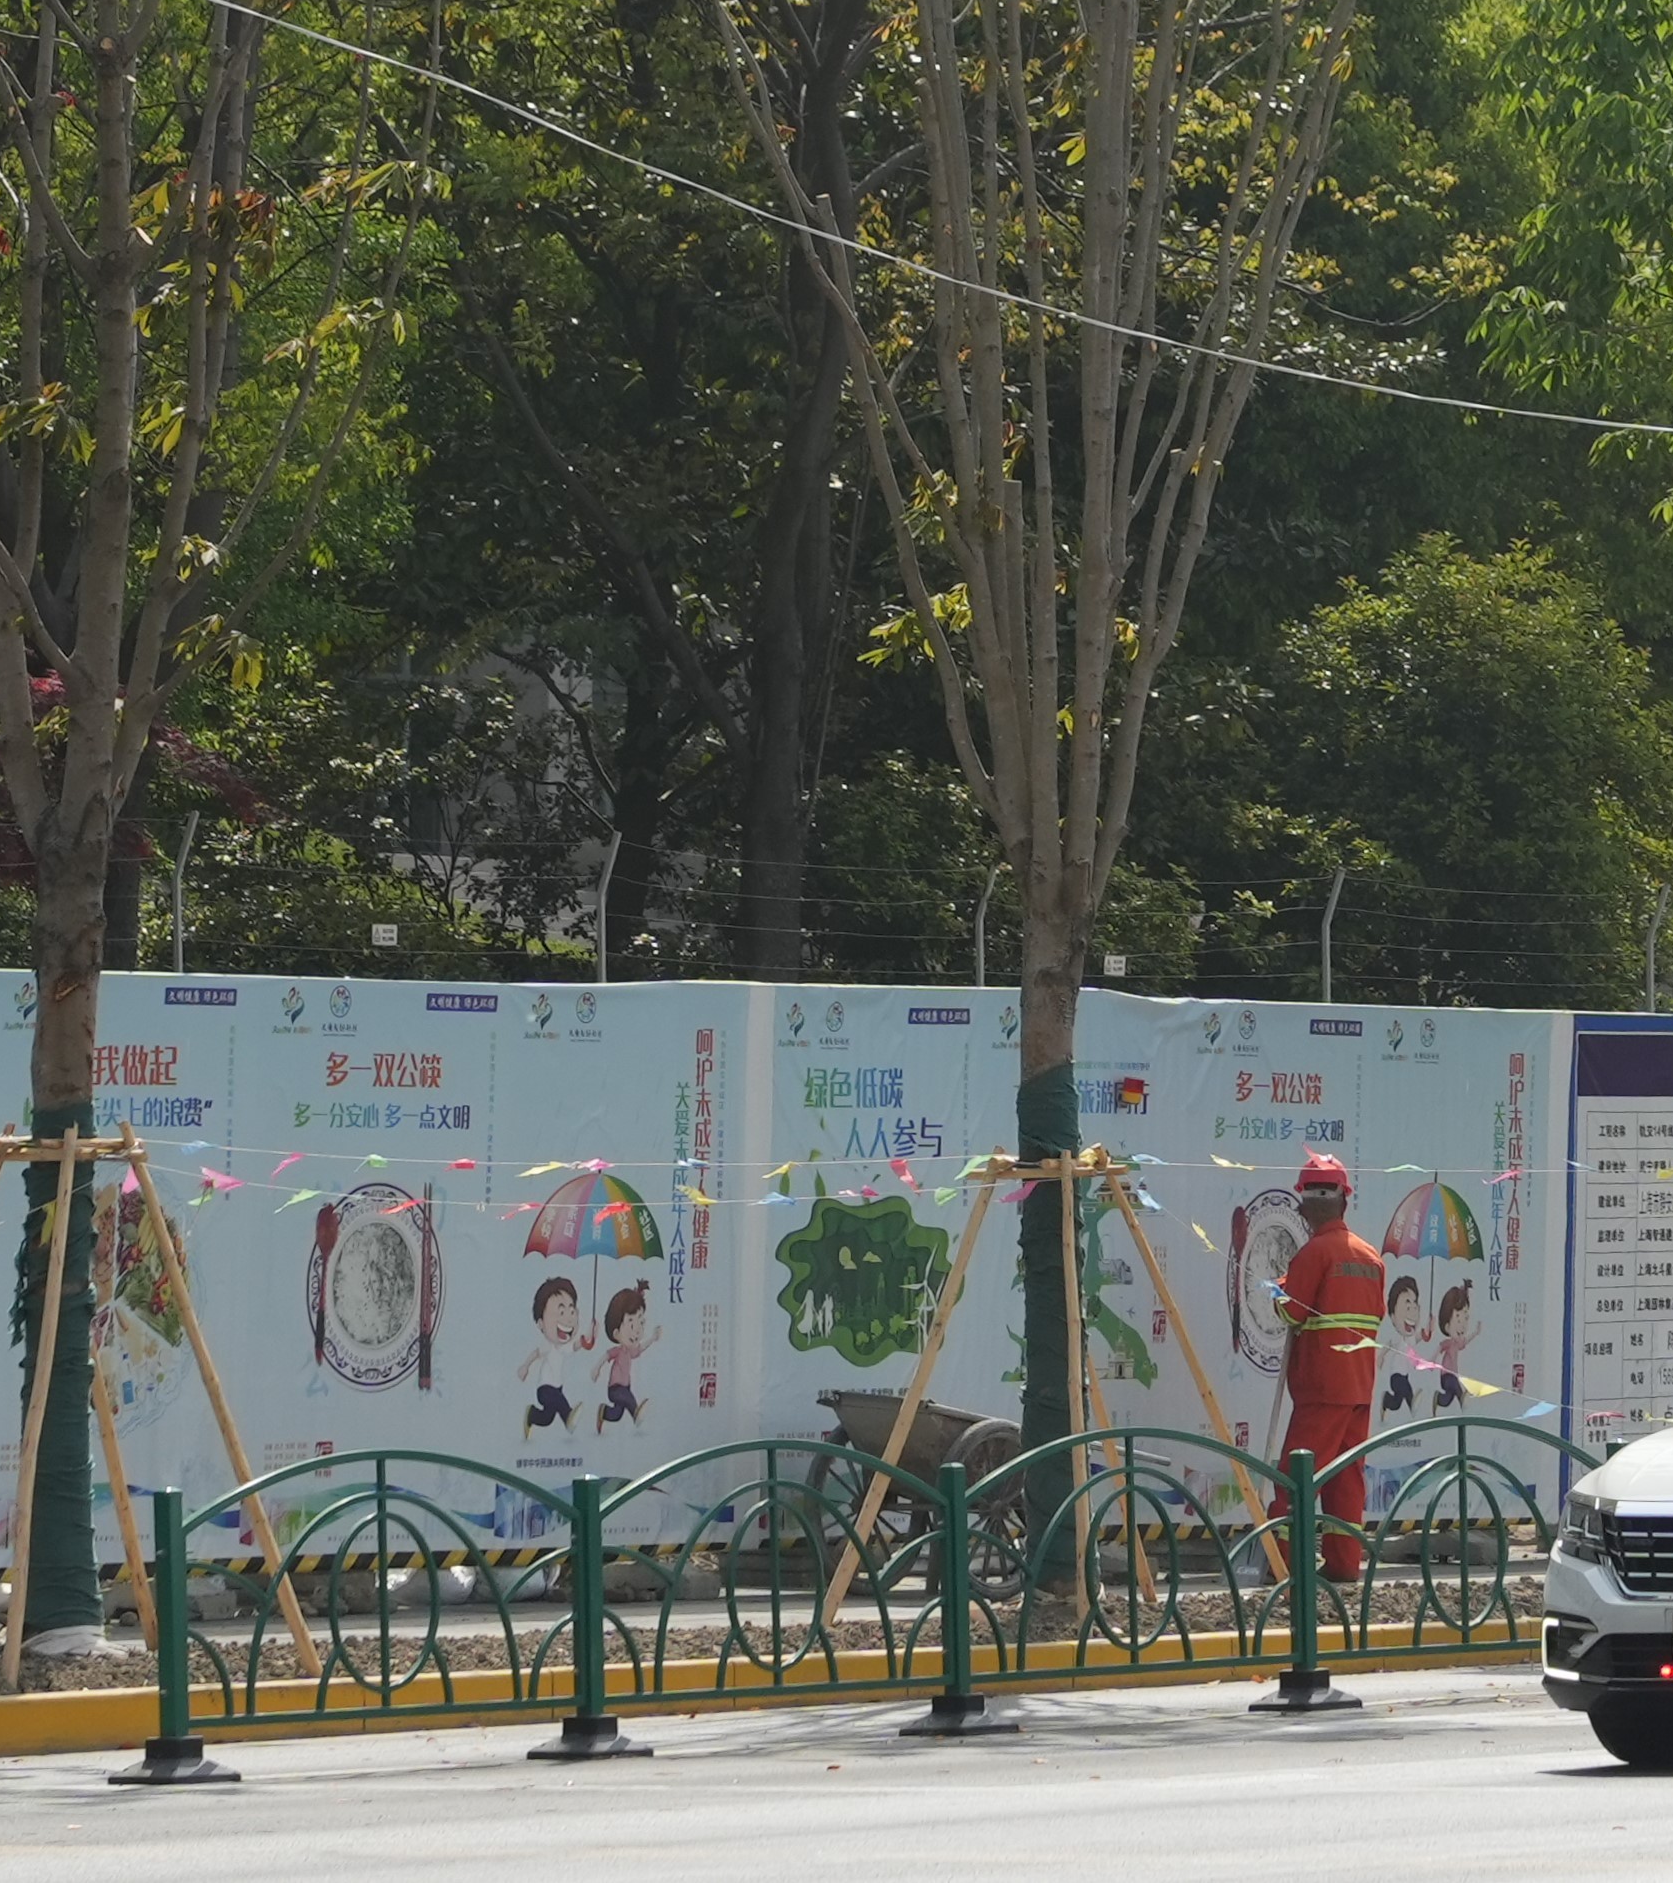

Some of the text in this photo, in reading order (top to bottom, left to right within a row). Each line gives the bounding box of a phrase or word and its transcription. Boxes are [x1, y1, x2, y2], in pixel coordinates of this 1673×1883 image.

[326, 1052, 443, 1088] 多一双公筷
[1235, 1070, 1322, 1105] 多一双公筷
[804, 1067, 904, 1109] 绿色低碳
[294, 1101, 471, 1130] 多一分安心 多一点文明
[1214, 1116, 1344, 1142] 多一分安心 多一点文明
[845, 1117, 944, 1158] 人人参与
